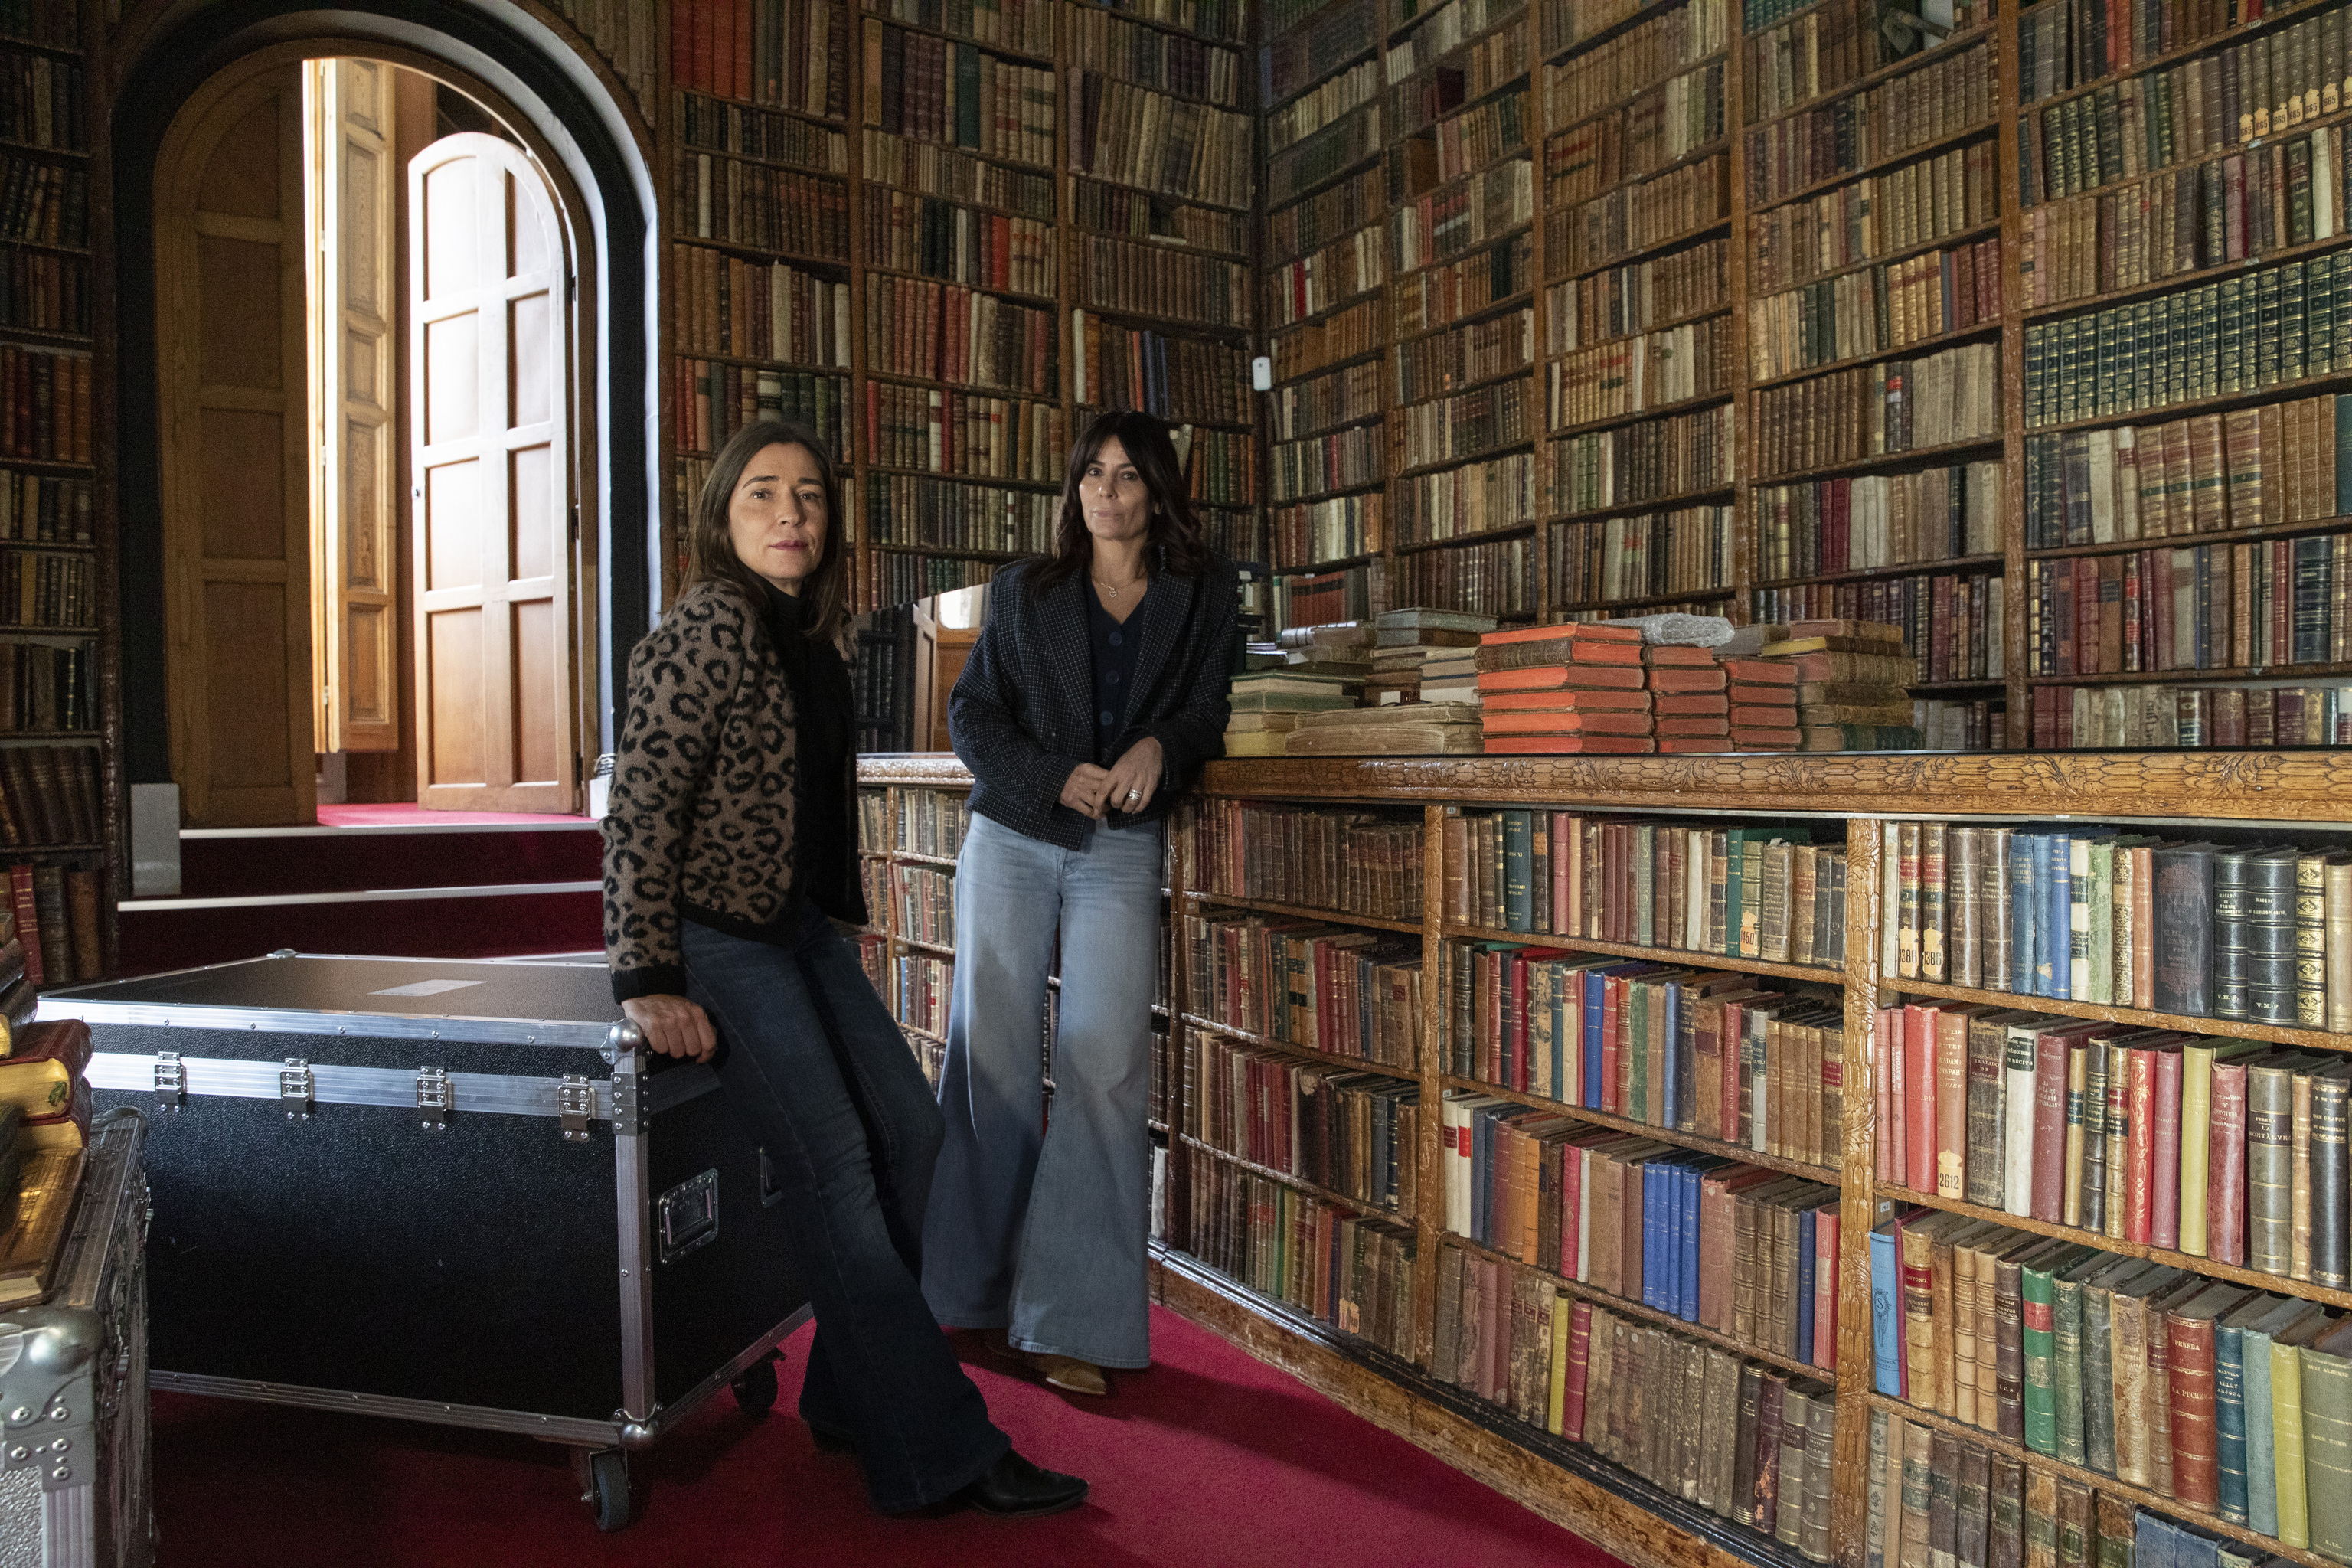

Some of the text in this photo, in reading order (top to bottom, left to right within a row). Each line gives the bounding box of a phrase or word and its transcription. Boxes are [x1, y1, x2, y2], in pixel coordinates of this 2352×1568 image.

[1740, 930, 1755, 946] 1450
[1899, 949, 1918, 963] 1386
[1923, 950, 1942, 965] 1386
[1936, 1067, 1965, 1076] ONAPART
[1939, 1173, 1959, 1189] 2612
[2174, 1339, 2200, 1351] PEREDA
[2171, 1386, 2180, 1396] LA
